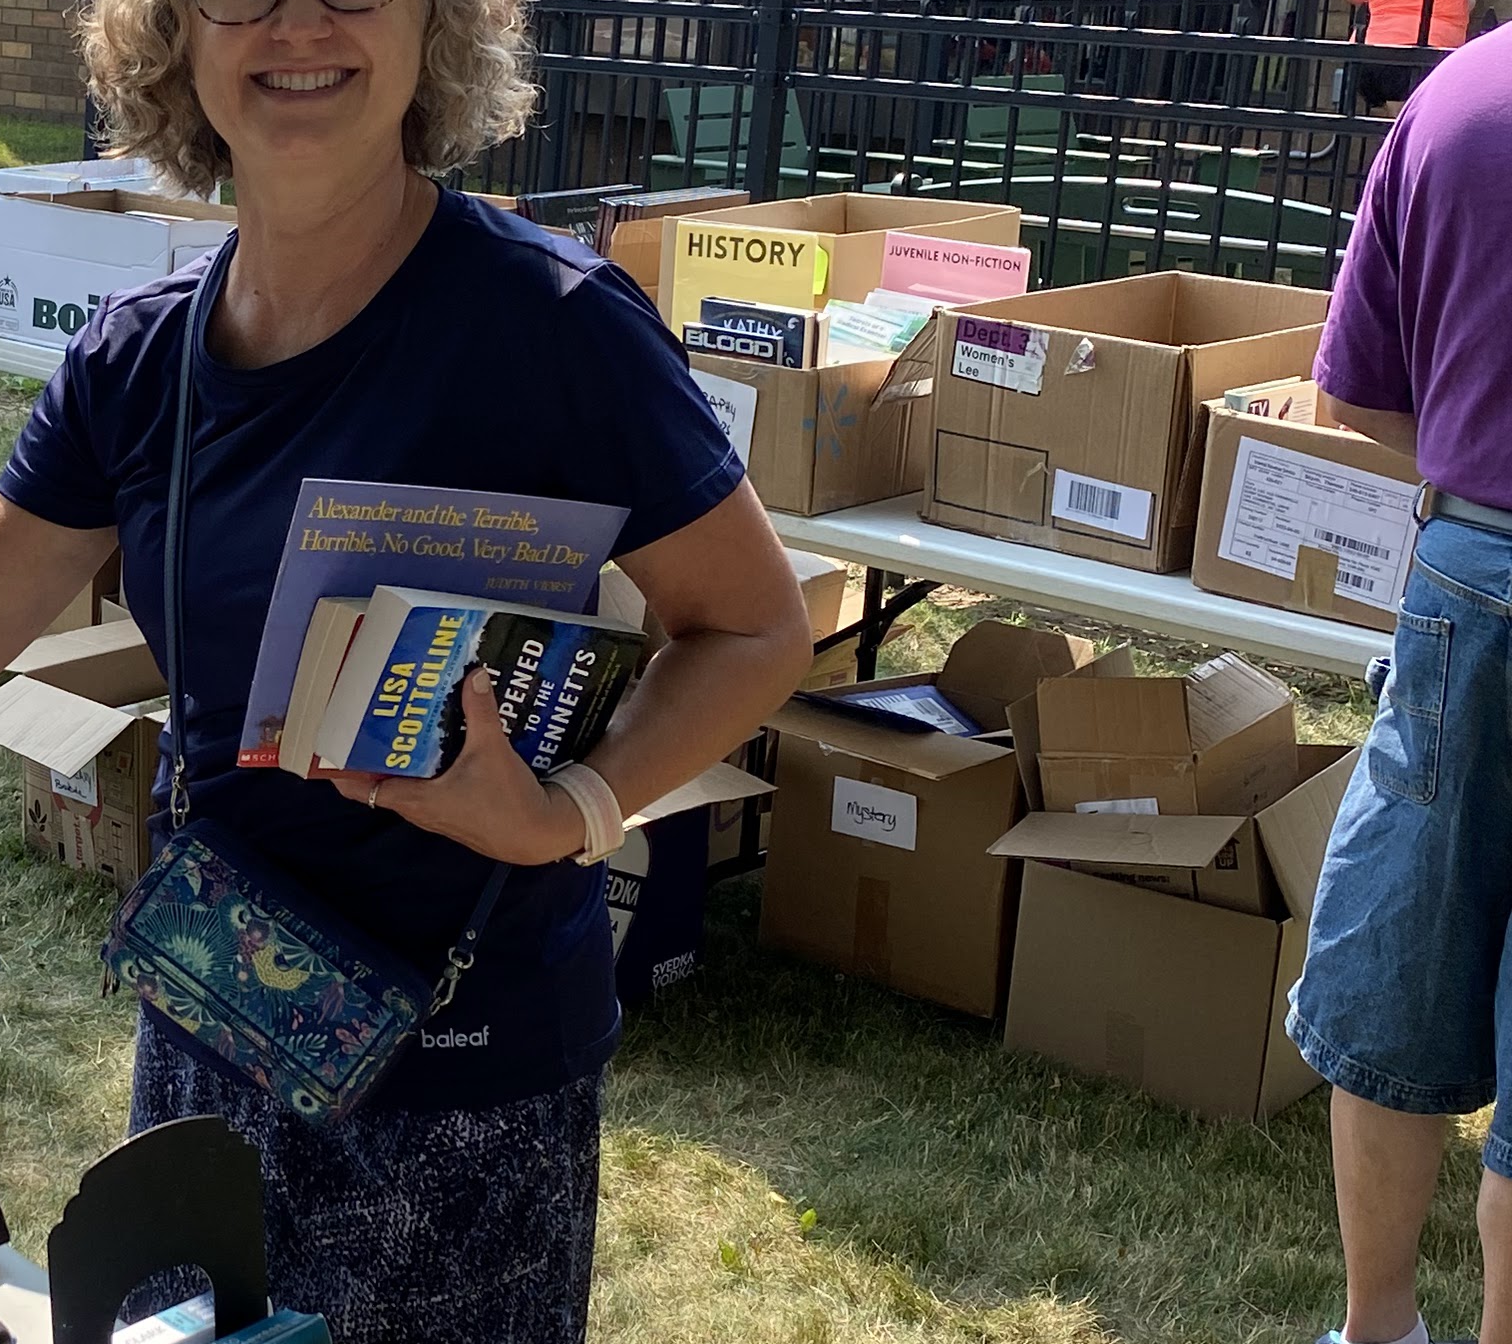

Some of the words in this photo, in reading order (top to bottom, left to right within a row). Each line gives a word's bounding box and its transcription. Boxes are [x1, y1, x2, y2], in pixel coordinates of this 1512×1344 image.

[688, 232, 805, 268] HISTORY
[889, 244, 939, 262] JUVENILE
[942, 251, 1022, 272] NON-FICTION
[685, 328, 774, 358] BLOOD
[962, 320, 1011, 350] Dept.
[958, 361, 980, 378] Lee
[959, 344, 1016, 369] Women's
[308, 496, 401, 522] Alexander
[401, 504, 437, 525] and
[439, 506, 466, 526] the
[473, 507, 539, 536] Terrible,
[299, 529, 378, 557] Horrible,
[381, 532, 408, 554] No
[413, 534, 465, 561] Good,
[474, 538, 512, 564] Very
[512, 541, 551, 563] Bad
[552, 544, 590, 569] Day
[373, 662, 416, 718] LISA
[385, 614, 465, 770] SCOTTOLINE
[531, 679, 555, 711] THE
[523, 714, 541, 733] TO
[531, 648, 597, 771] BENNETTS
[846, 799, 897, 832] Mystery
[652, 950, 696, 978] SVEDKA
[652, 965, 695, 990] VODKA
[421, 1025, 490, 1049] baleaf
